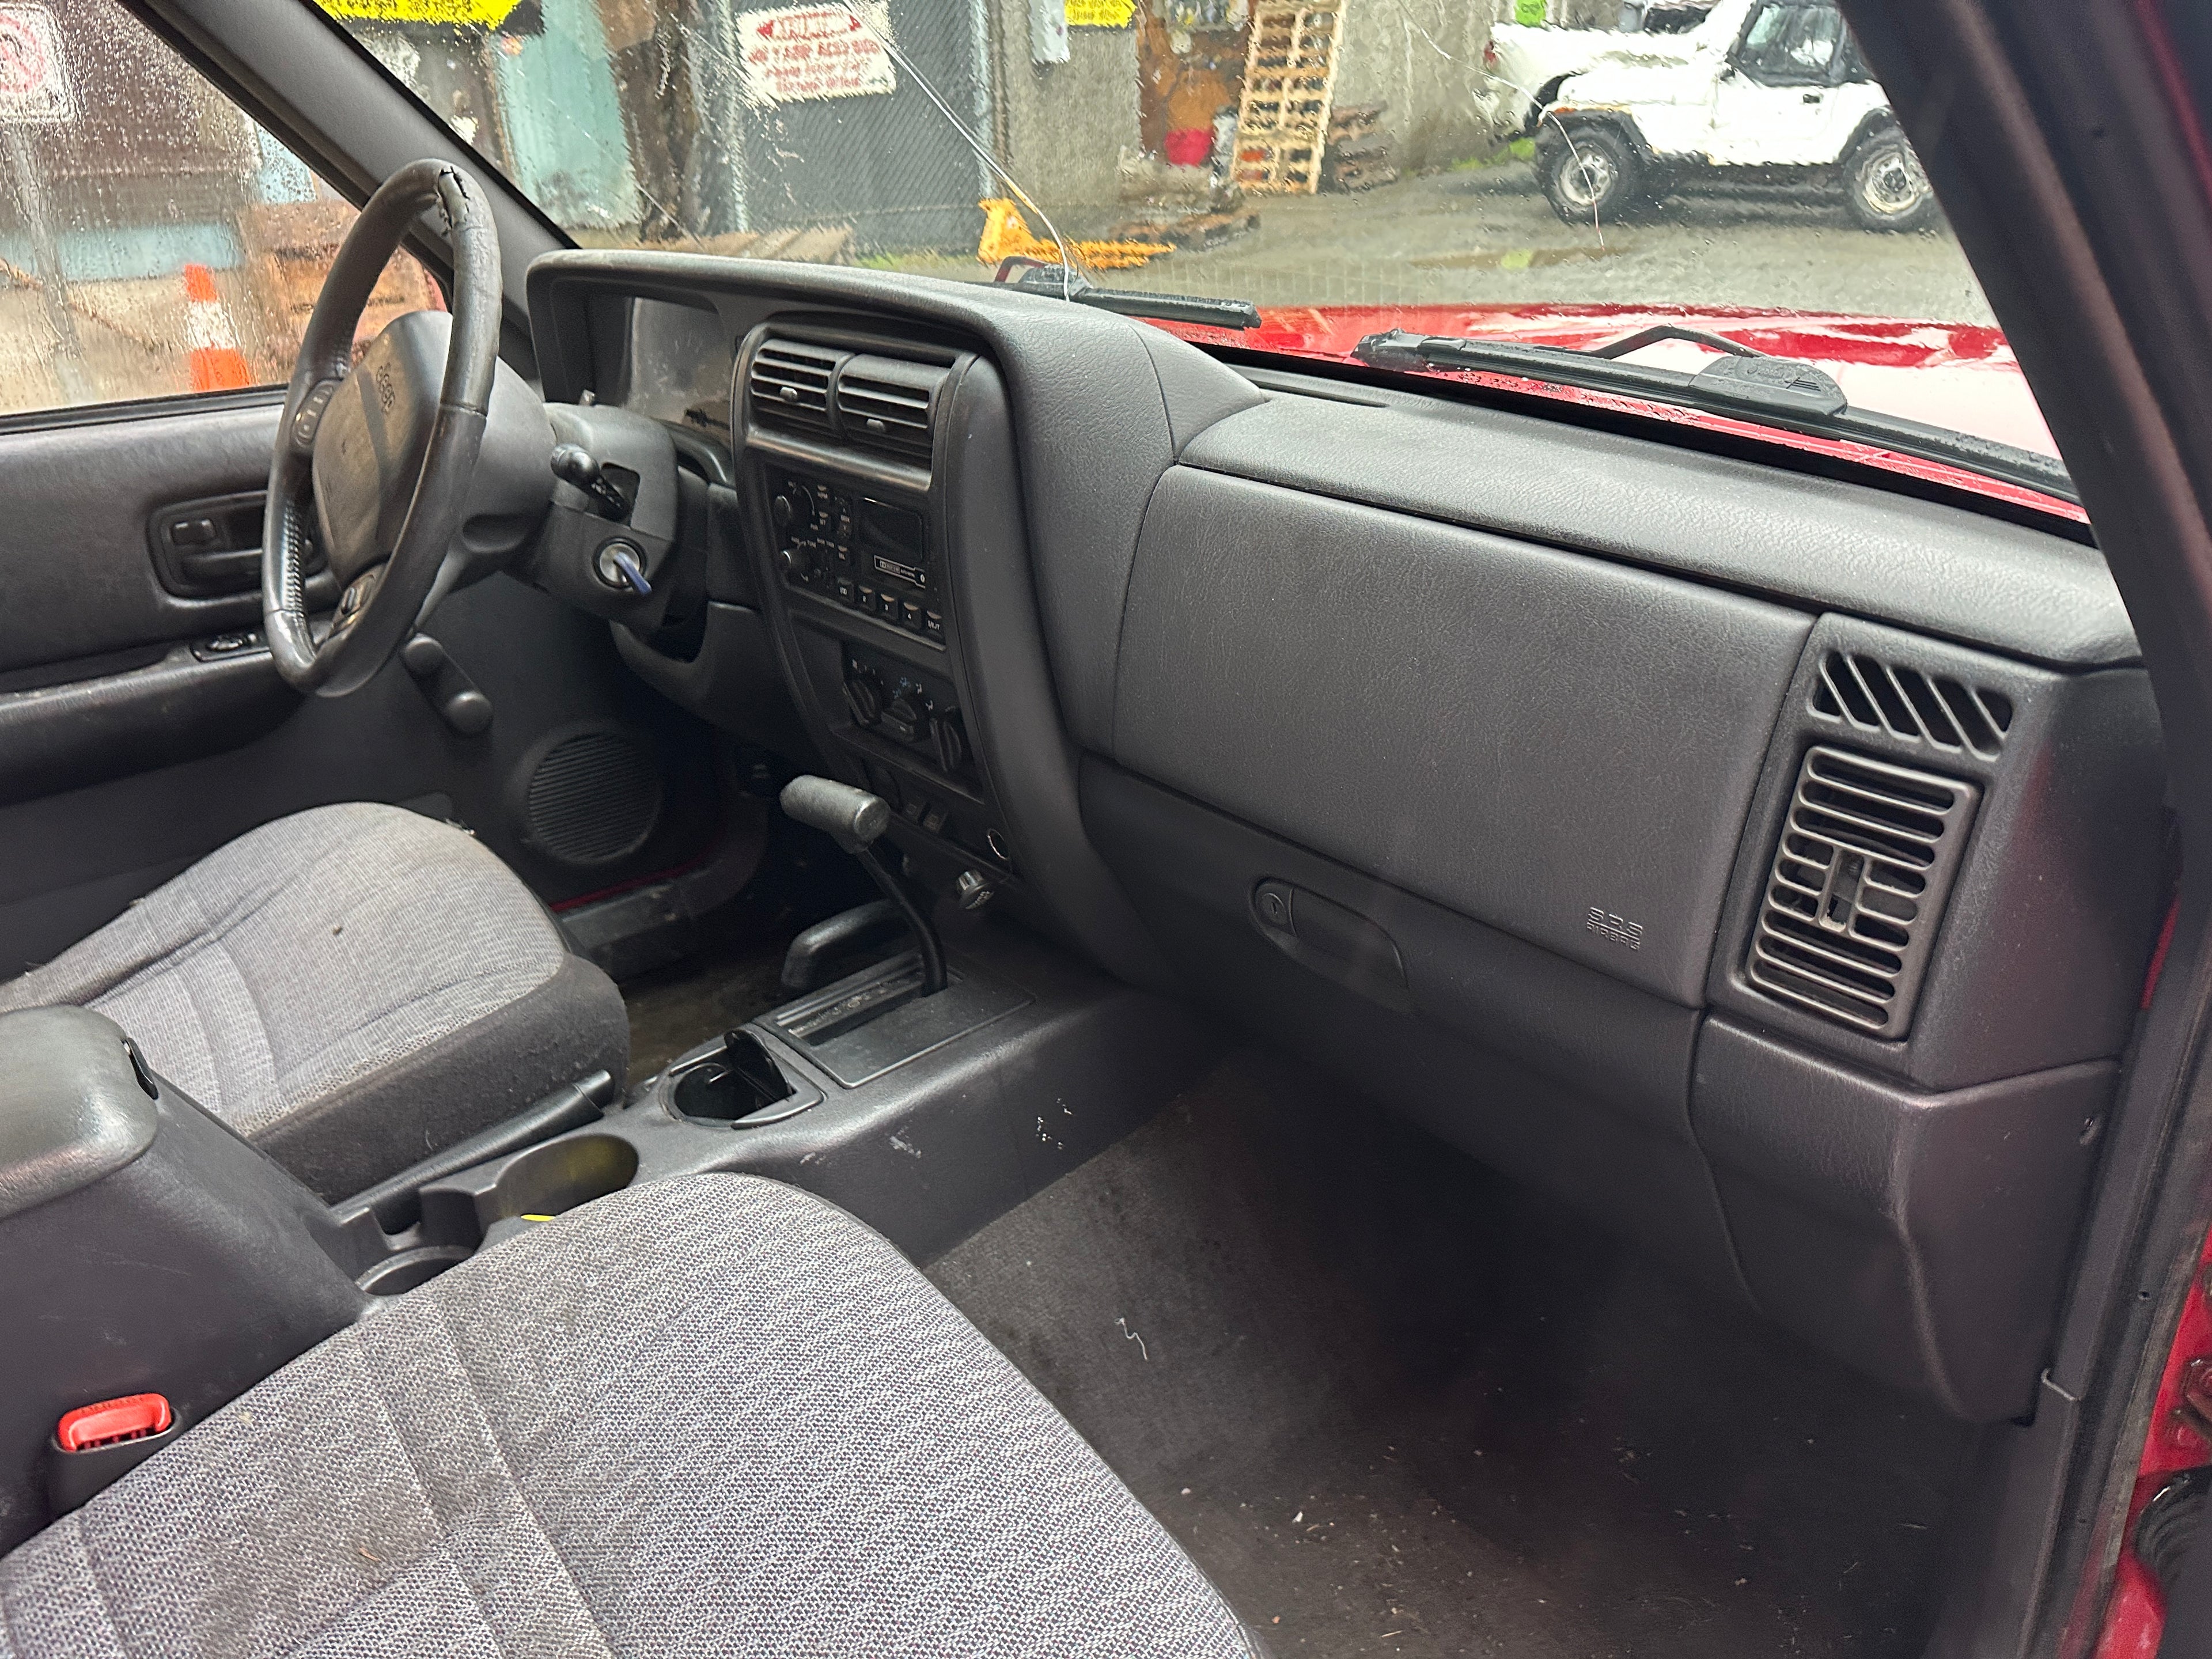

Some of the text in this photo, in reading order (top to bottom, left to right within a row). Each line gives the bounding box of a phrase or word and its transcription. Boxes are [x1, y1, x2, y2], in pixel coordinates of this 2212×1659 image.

[376, 362, 396, 415] Jeep
[1586, 922, 1641, 951] AIRBAG
[1588, 907, 1643, 937] SRS
